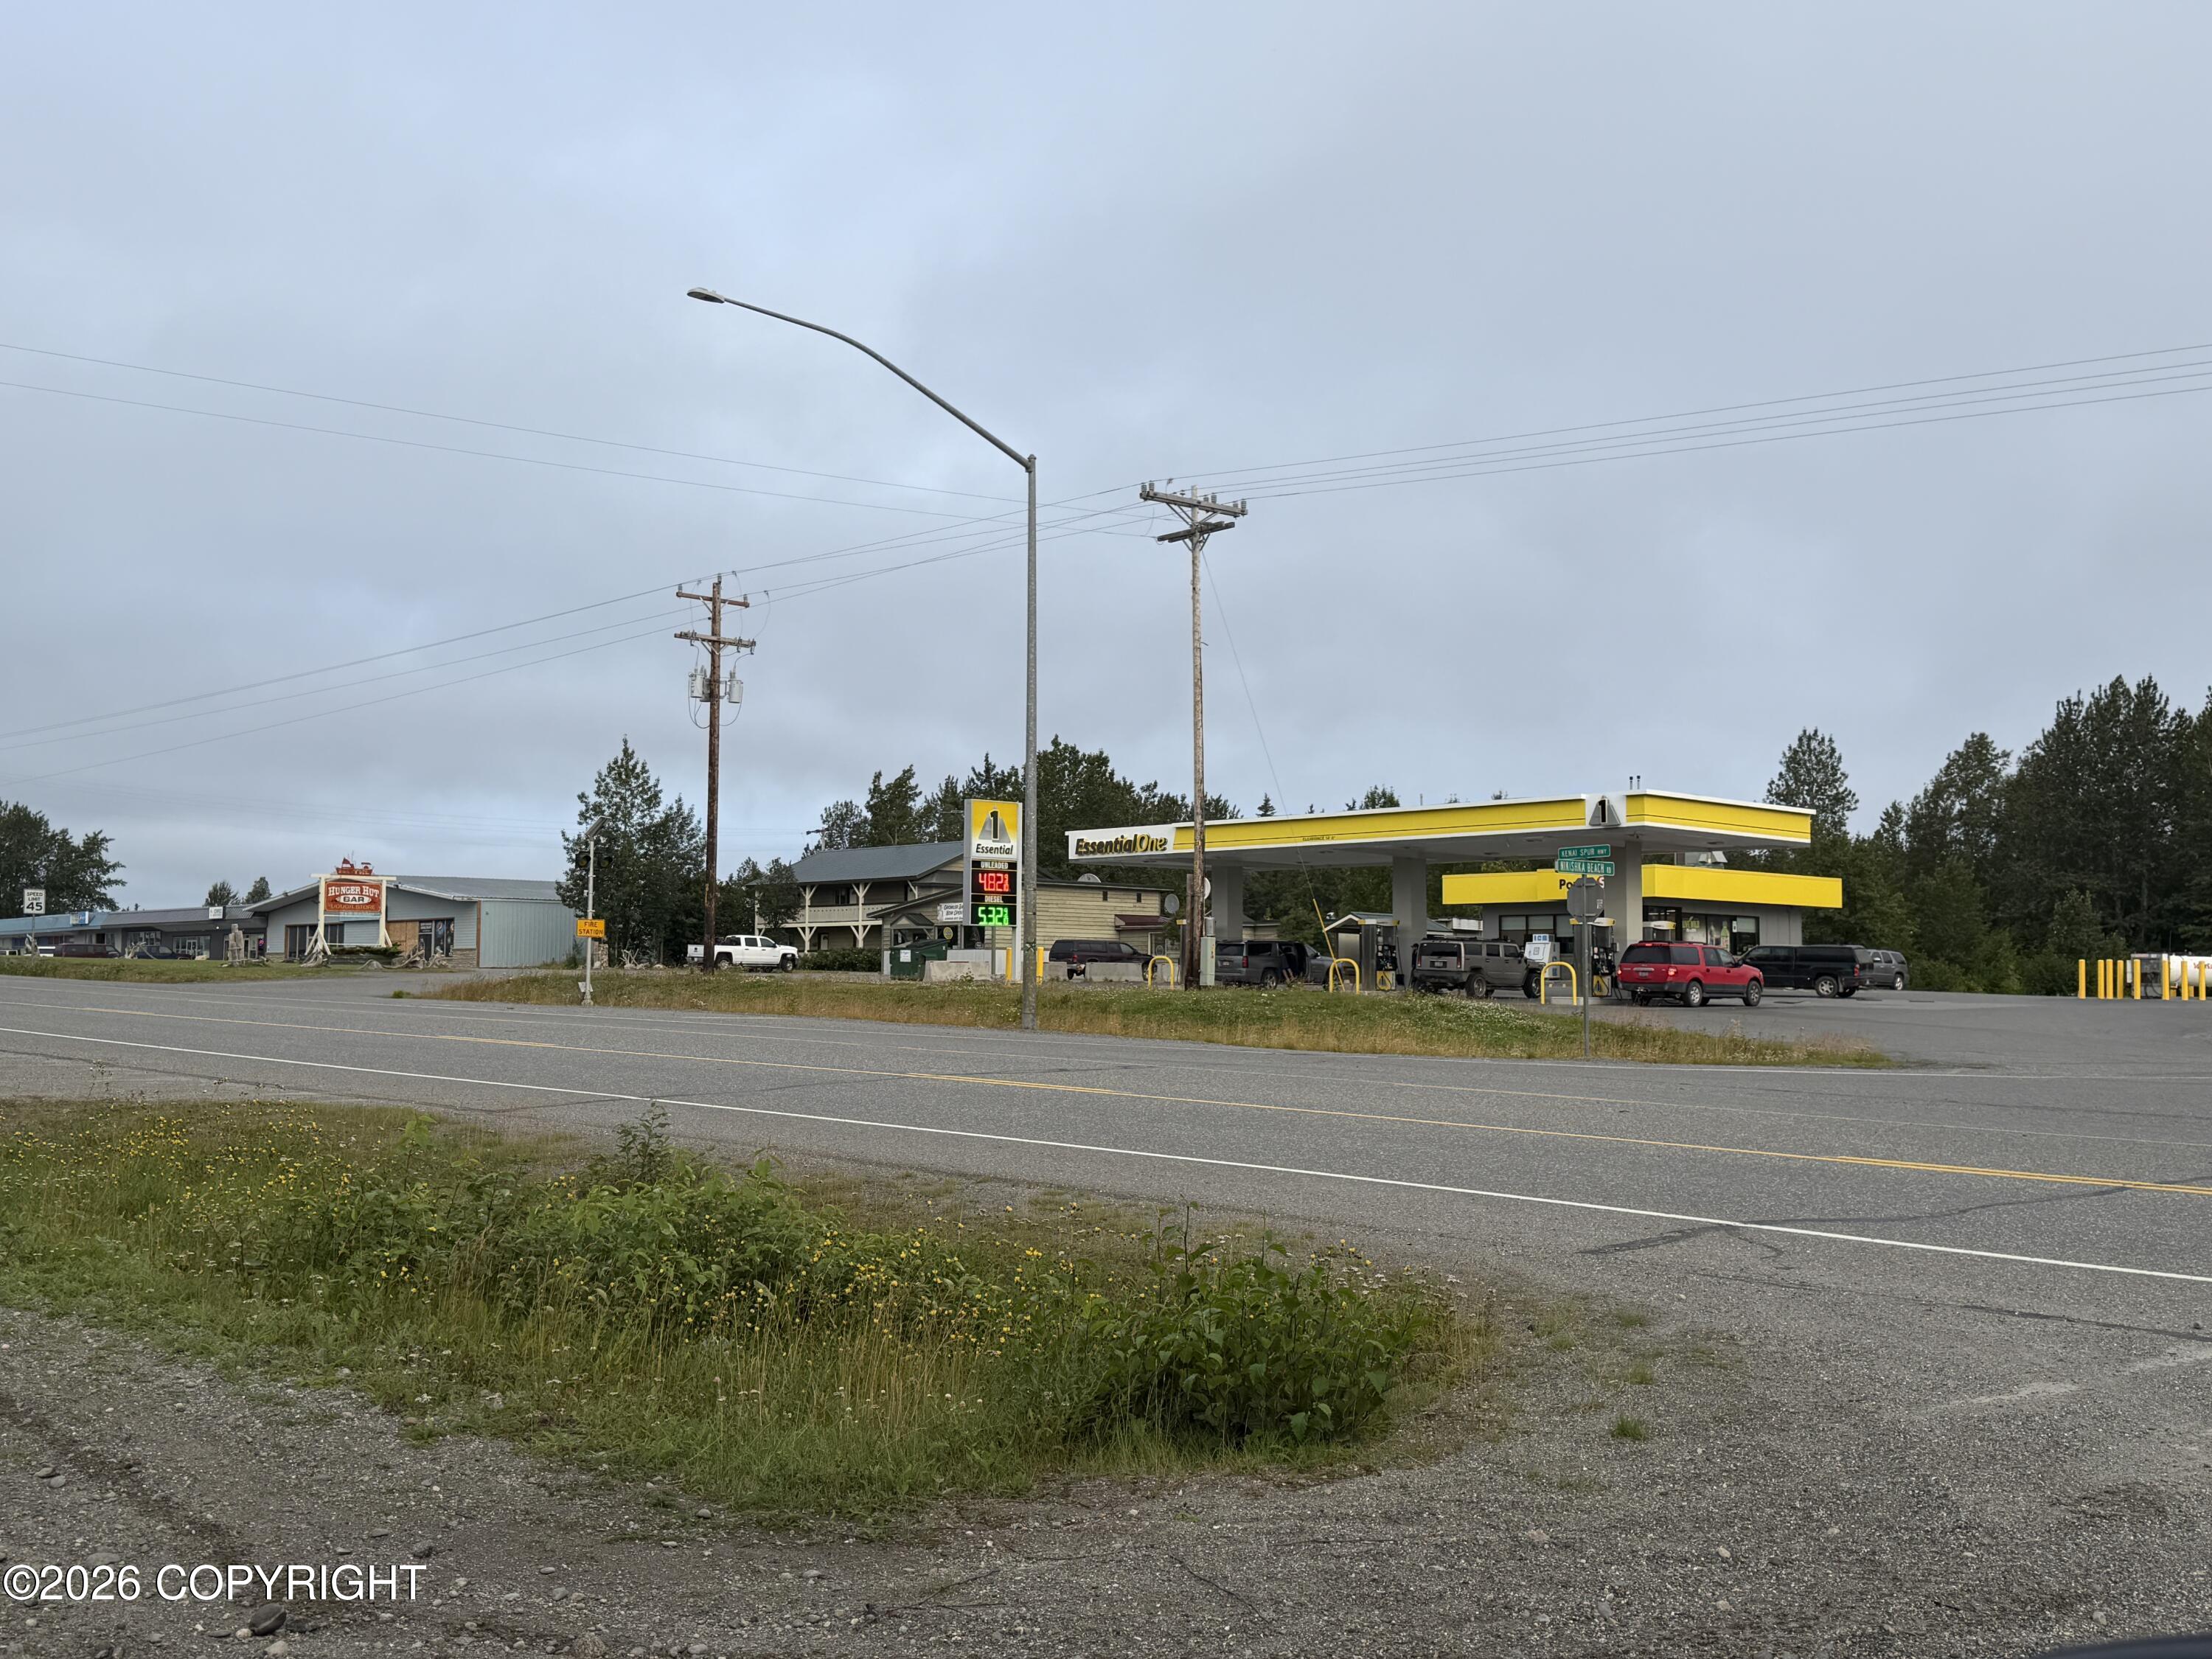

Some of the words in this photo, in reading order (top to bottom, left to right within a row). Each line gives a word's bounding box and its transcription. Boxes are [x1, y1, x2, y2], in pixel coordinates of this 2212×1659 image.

[990, 810, 999, 839] 1
[975, 844, 1013, 855] Essential
[1580, 848, 1595, 856] SPUR
[981, 861, 1009, 869] UNLEADED
[1560, 861, 1585, 872] NIKISHKA
[1587, 863, 1604, 874] BEACH
[984, 895, 1004, 903] DIESEL
[26, 902, 43, 911] 45
